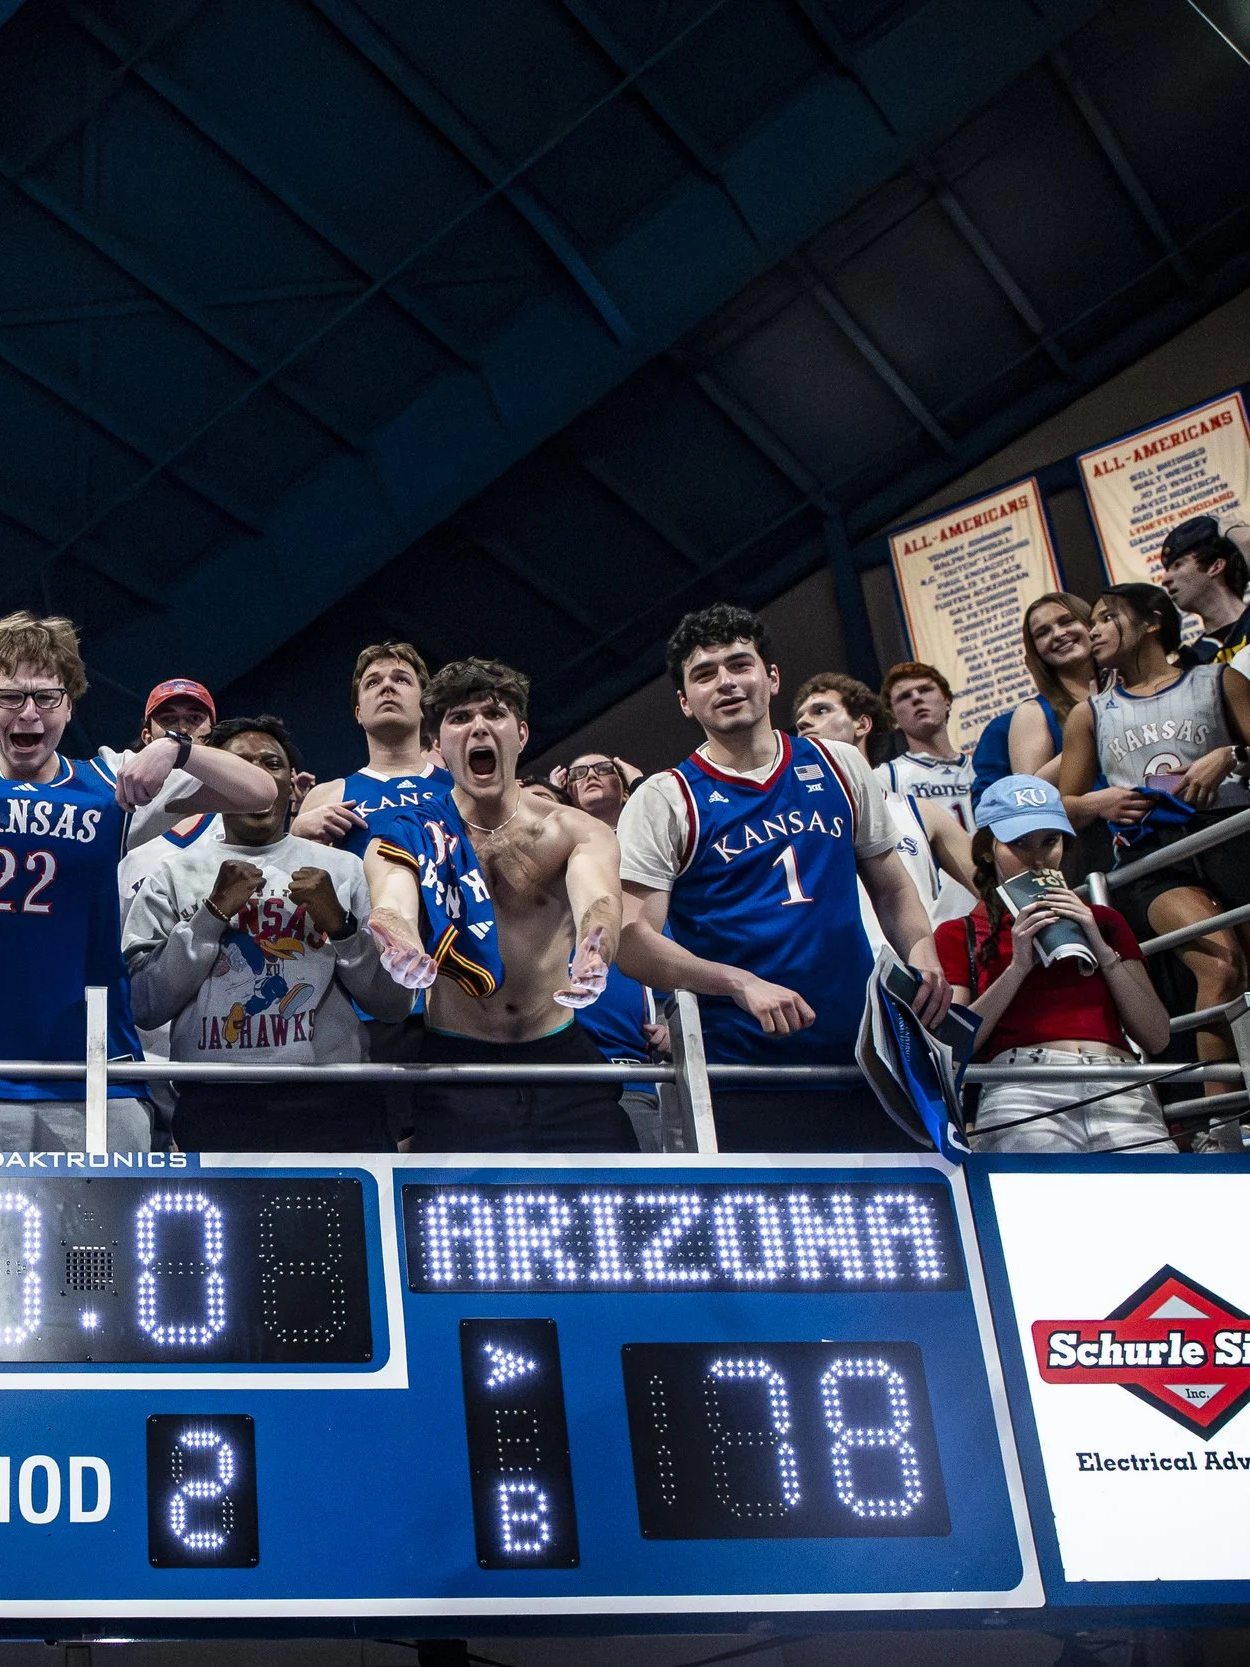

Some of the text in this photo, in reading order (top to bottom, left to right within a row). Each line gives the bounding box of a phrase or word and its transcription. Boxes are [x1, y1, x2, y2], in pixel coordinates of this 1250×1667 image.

[1094, 411, 1234, 478] ALL-AMERICANS
[903, 495, 1029, 556] ALL-AMERICANS
[1108, 719, 1211, 762] KANSAS
[911, 783, 971, 798] Kans
[1013, 788, 1048, 807] KU
[711, 810, 844, 865] KANSAS
[772, 844, 814, 906] 1
[426, 1194, 942, 1282] ARIZONA
[1048, 1331, 1205, 1368] Schurle
[1185, 1388, 1210, 1399] Inc.
[708, 1358, 924, 1518] 78
[1077, 1452, 1250, 1472] Electrical Adv
[169, 1430, 235, 1550] 2
[497, 1483, 550, 1551] B
